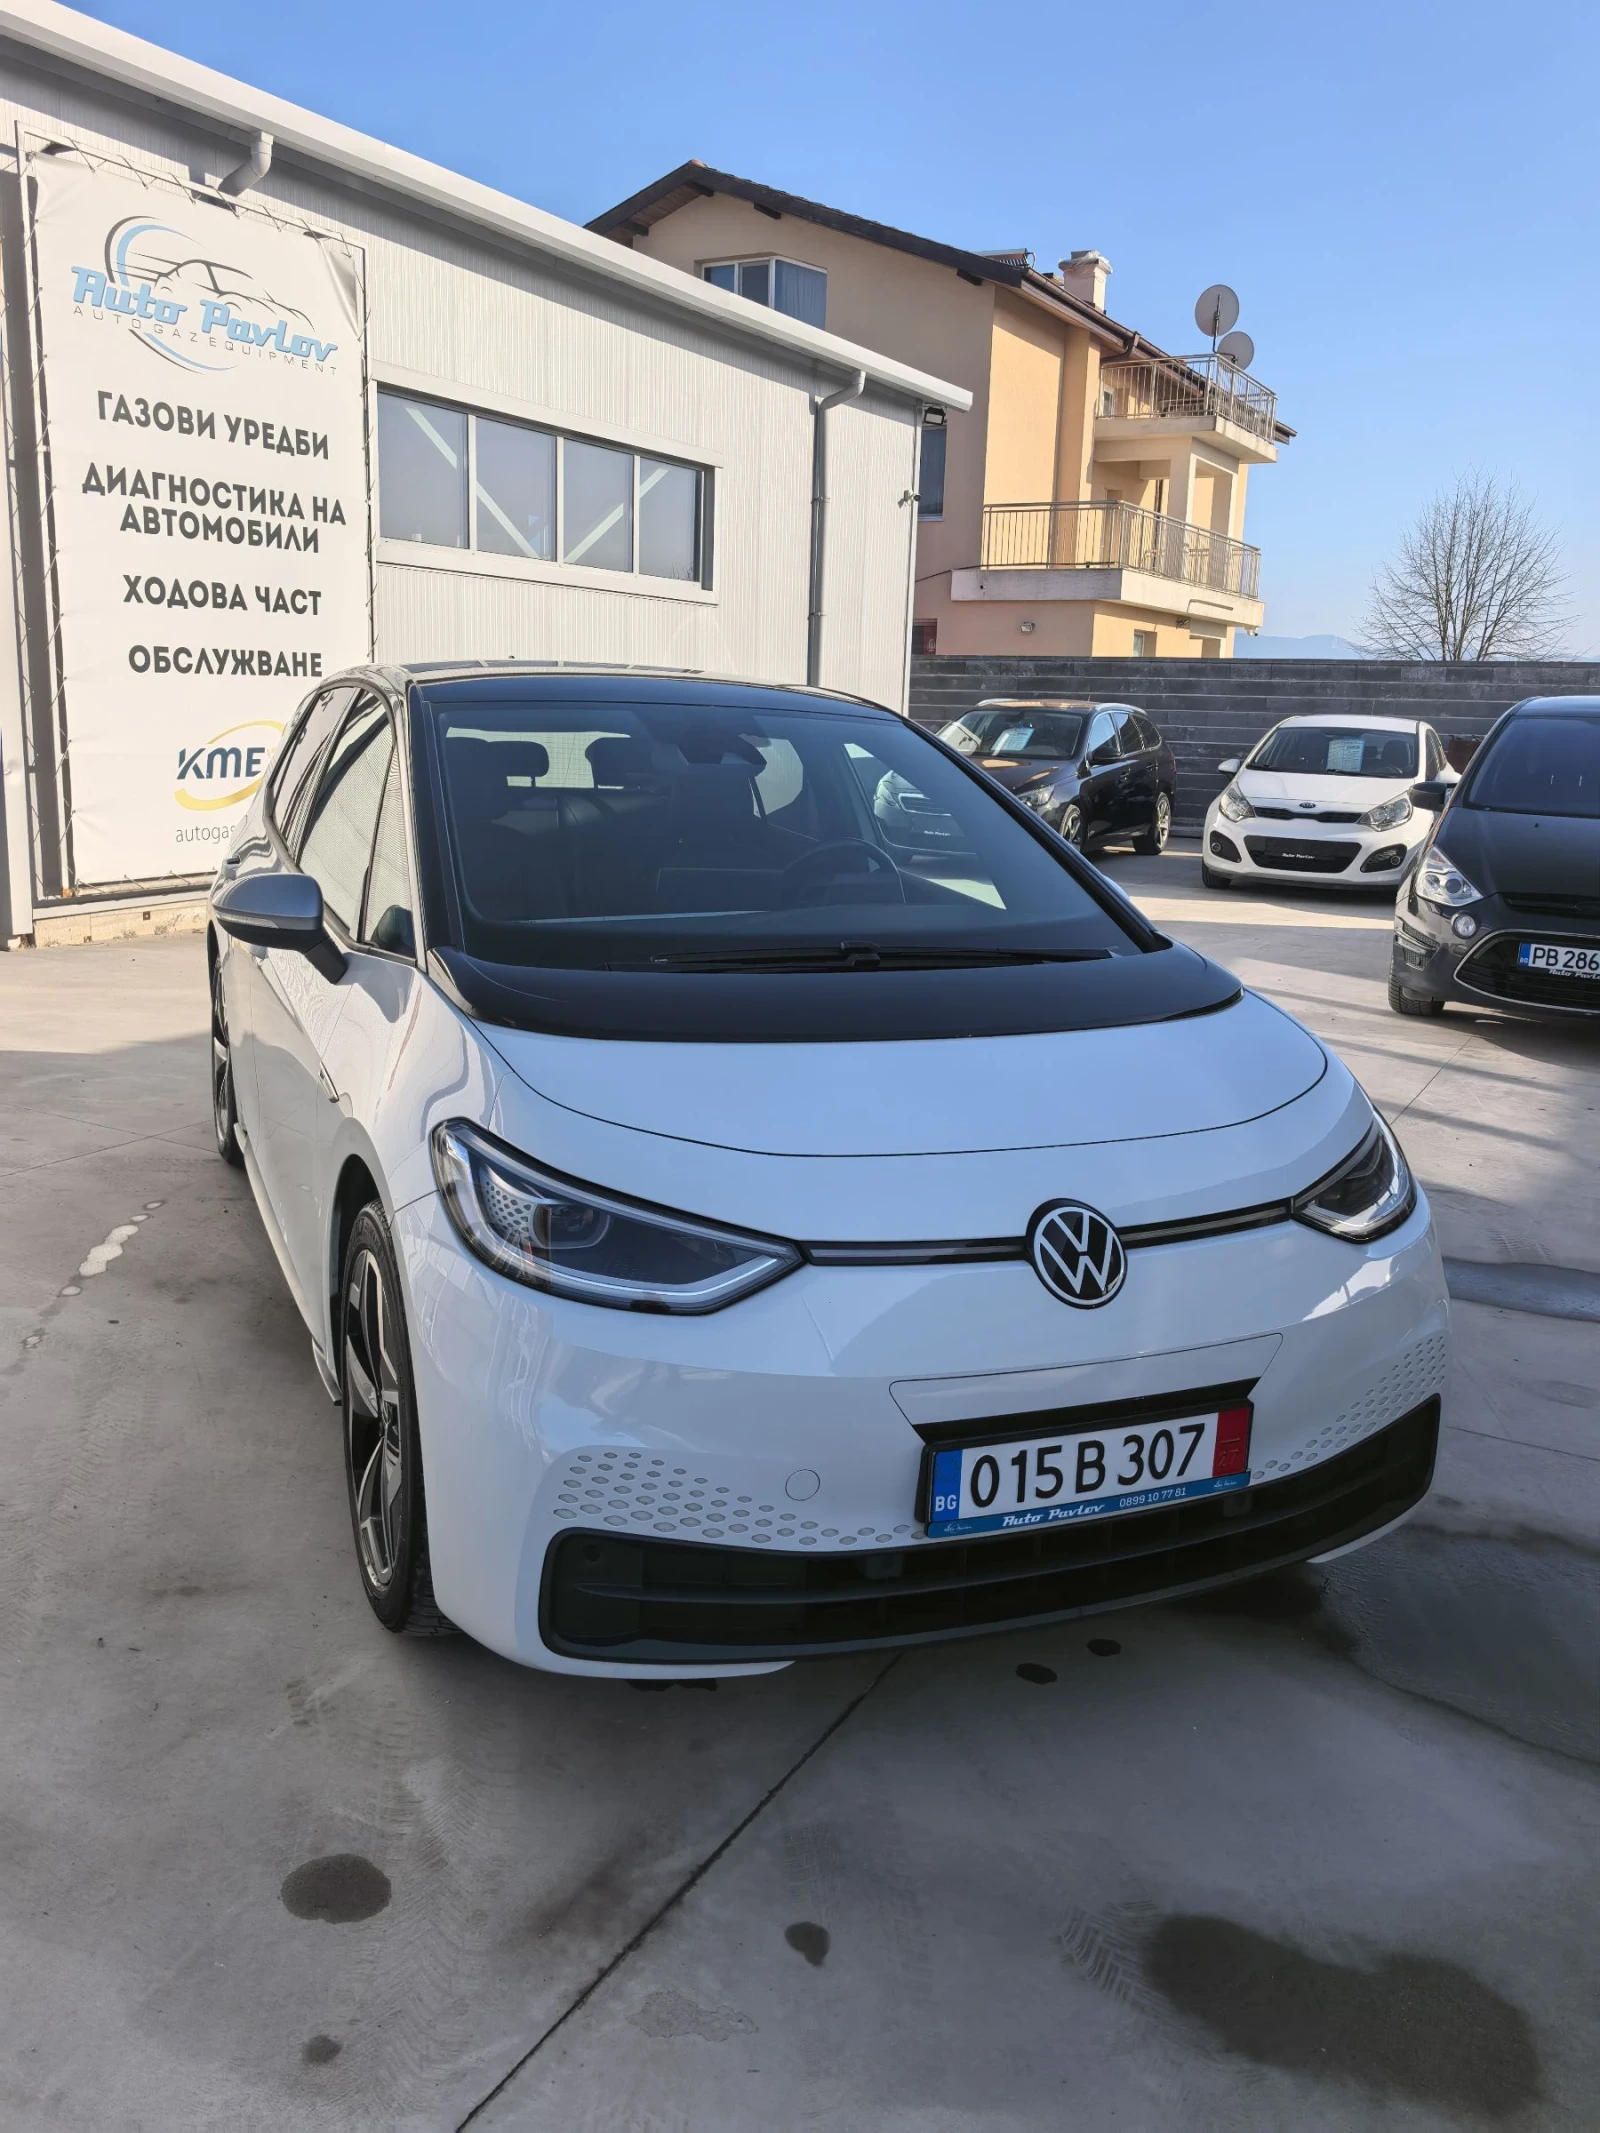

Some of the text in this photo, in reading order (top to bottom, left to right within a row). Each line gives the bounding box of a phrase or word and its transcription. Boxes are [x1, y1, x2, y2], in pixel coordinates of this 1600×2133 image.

[71, 266, 188, 325] Auto
[208, 335, 338, 376] EQUIPMENT
[97, 390, 329, 460] ГАЗОВИ УРЕДБИ
[81, 462, 347, 526] ДИАГНОСТИКА НА
[119, 503, 319, 554] АВТОМОБИЛИ
[122, 574, 322, 616] ХОДОВА ЧАСТ
[127, 644, 323, 678] ОБСЛУЖВАНЕ
[176, 746, 266, 780] KME
[1532, 946, 1559, 967] PB
[935, 1494, 957, 1512] BG
[1119, 1494, 1146, 1508] 0899
[1002, 1513, 1044, 1527] Auto
